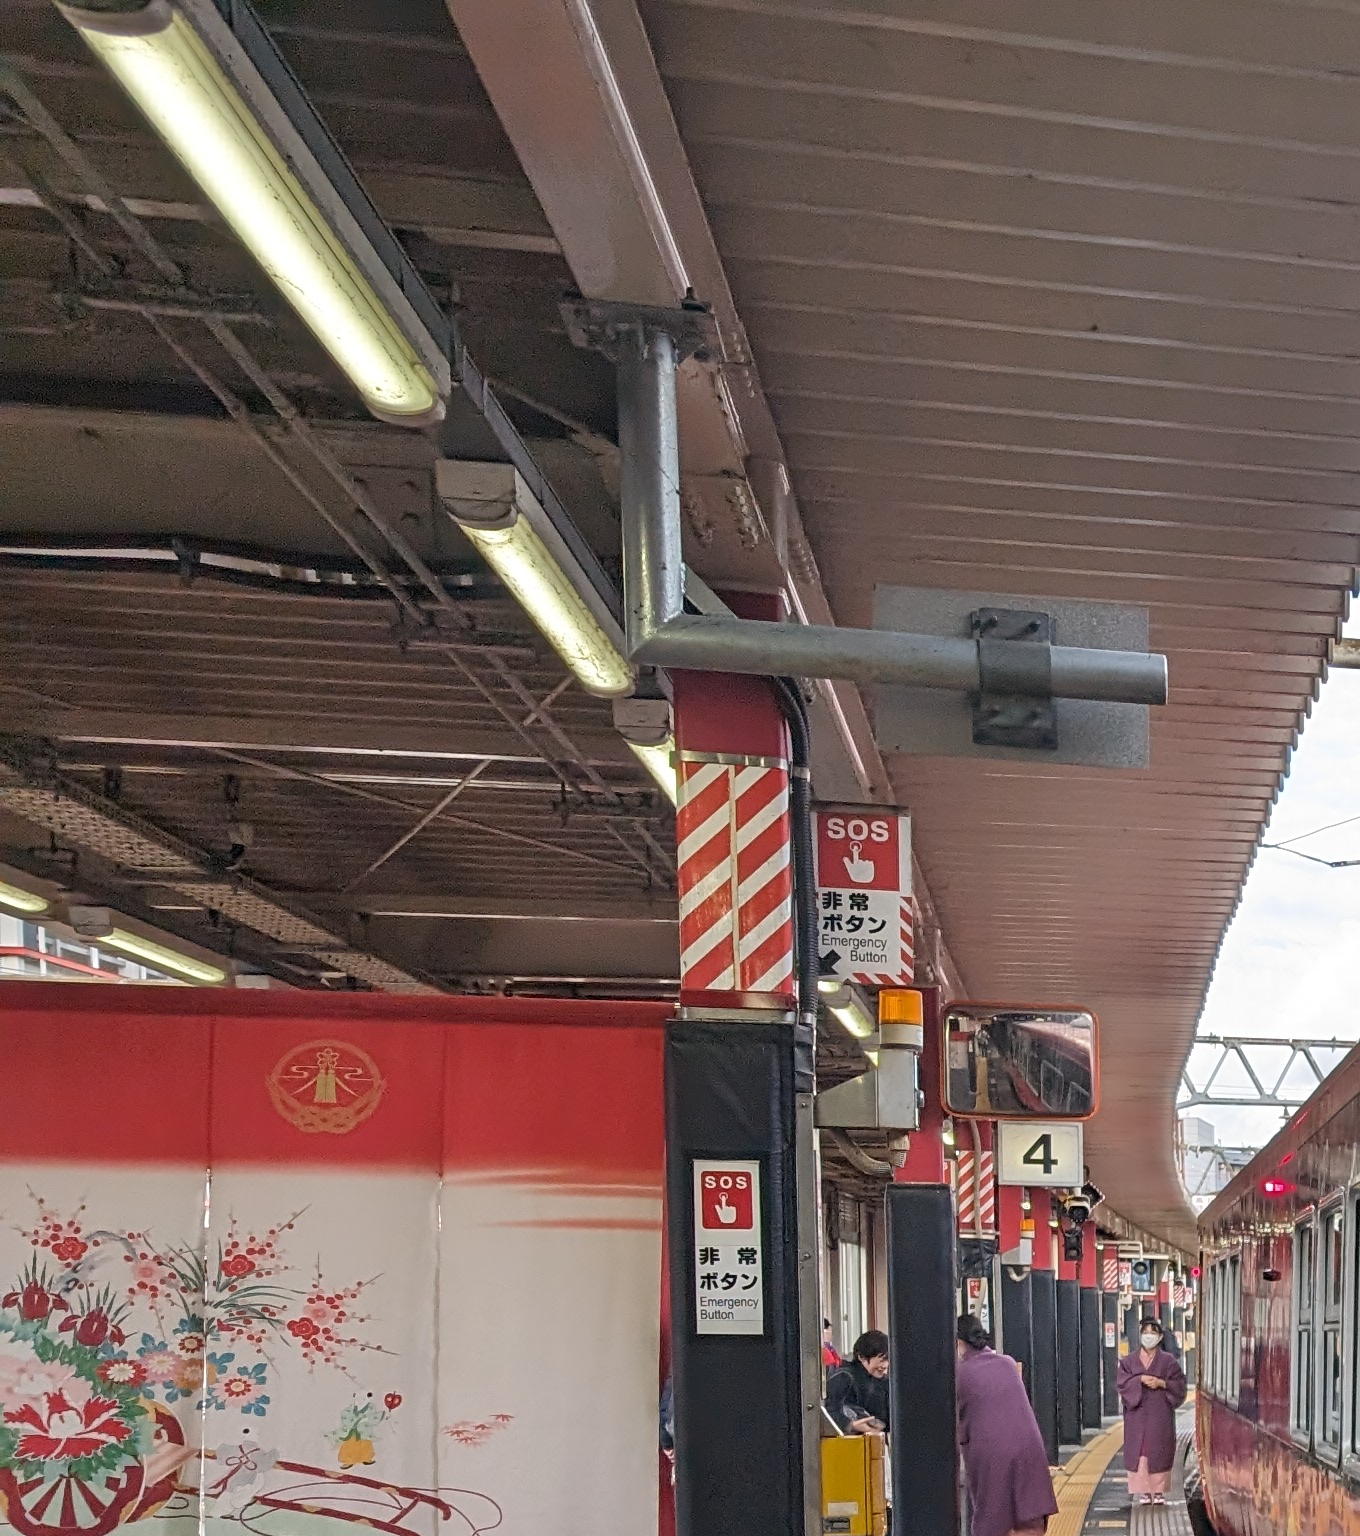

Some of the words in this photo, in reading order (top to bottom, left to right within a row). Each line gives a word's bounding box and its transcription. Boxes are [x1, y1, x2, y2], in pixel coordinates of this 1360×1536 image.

[827, 818, 889, 842] SOS
[821, 891, 869, 912] 非常
[822, 914, 887, 934] ボタン
[822, 934, 887, 950] Emergency
[850, 950, 887, 963] Button
[1023, 1133, 1059, 1174] 4
[704, 1175, 748, 1189] SOS
[699, 1247, 758, 1265] 非常
[700, 1273, 758, 1291] ボタン
[700, 1296, 759, 1309] Emergency
[700, 1309, 734, 1320] Button
